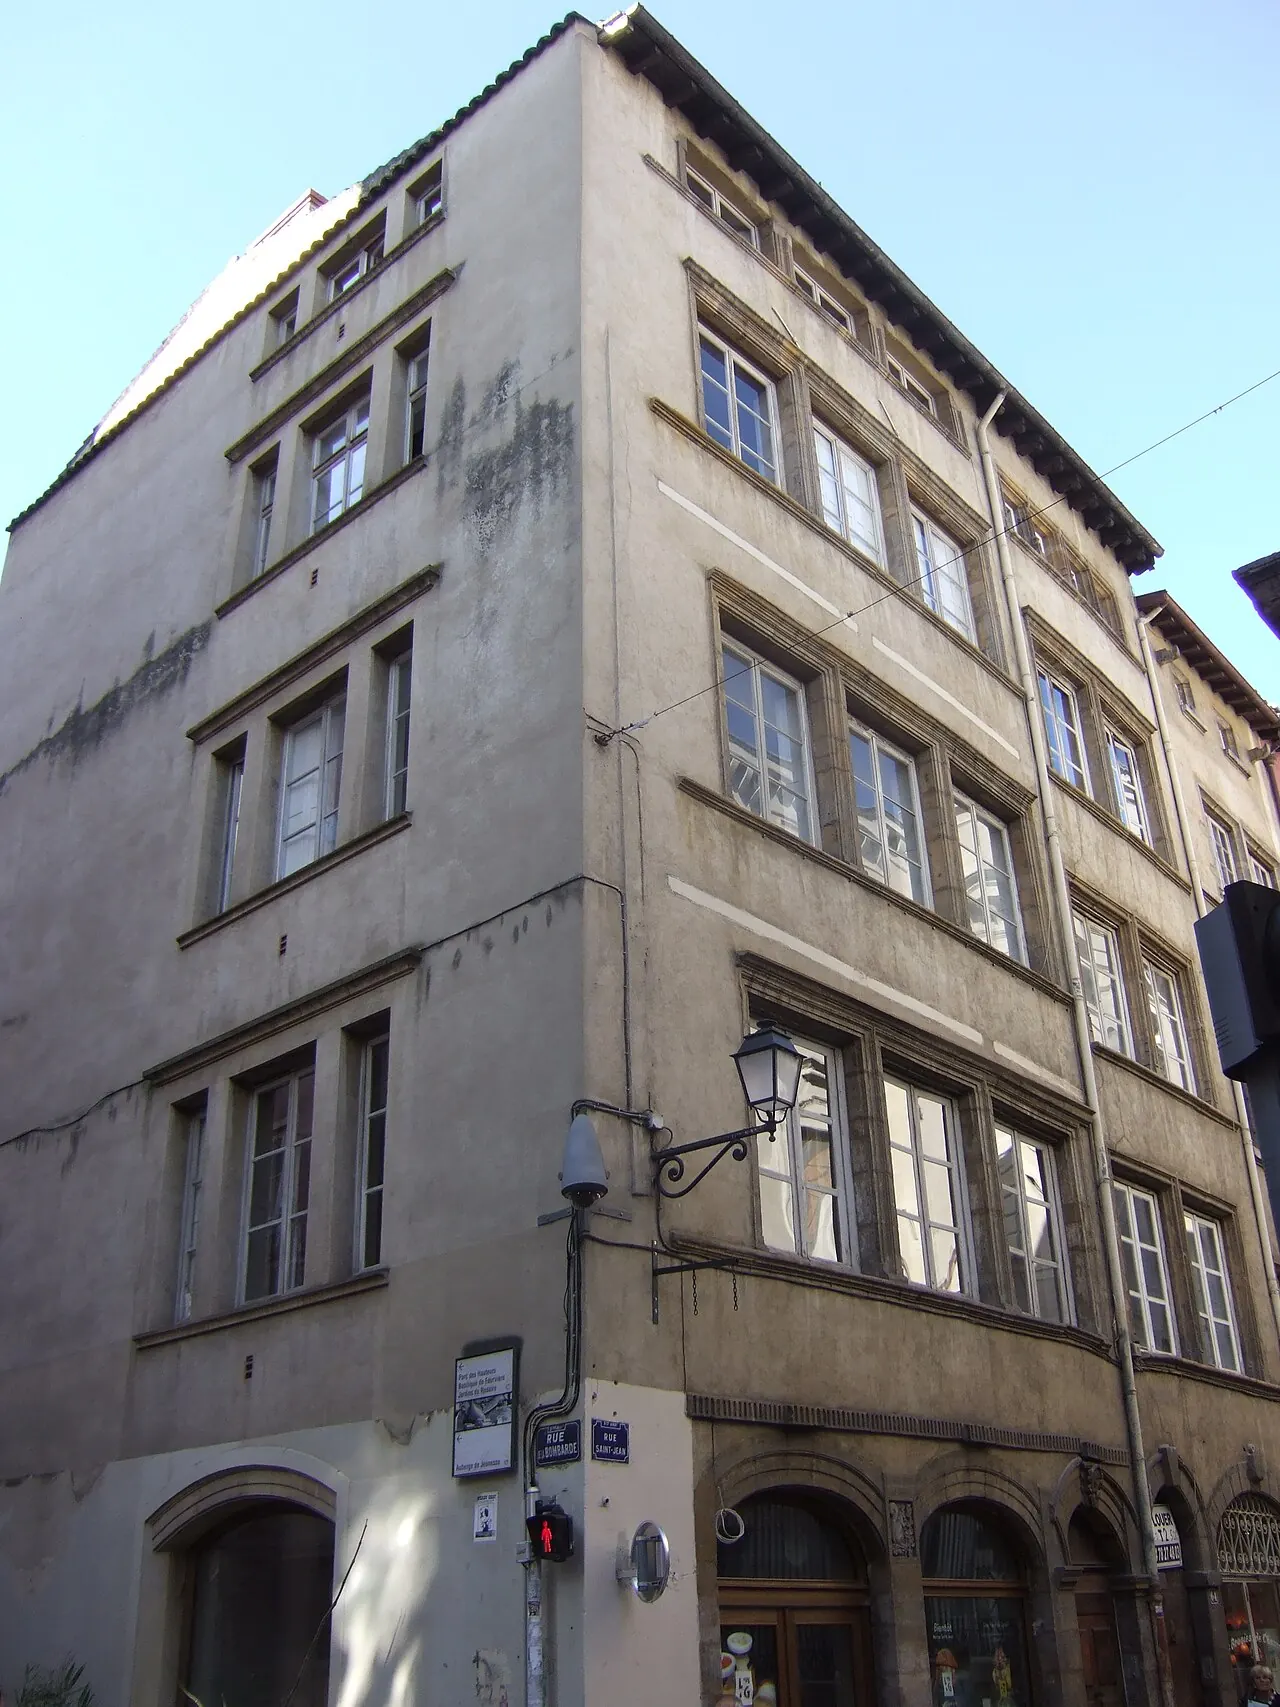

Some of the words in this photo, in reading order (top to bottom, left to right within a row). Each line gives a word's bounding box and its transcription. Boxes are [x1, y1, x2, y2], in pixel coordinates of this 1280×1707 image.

[546, 1431, 565, 1444] RUE
[603, 1432, 617, 1442] RUE
[544, 1442, 578, 1459] BOMBARDE
[595, 1444, 627, 1456] SAINT-JEAN
